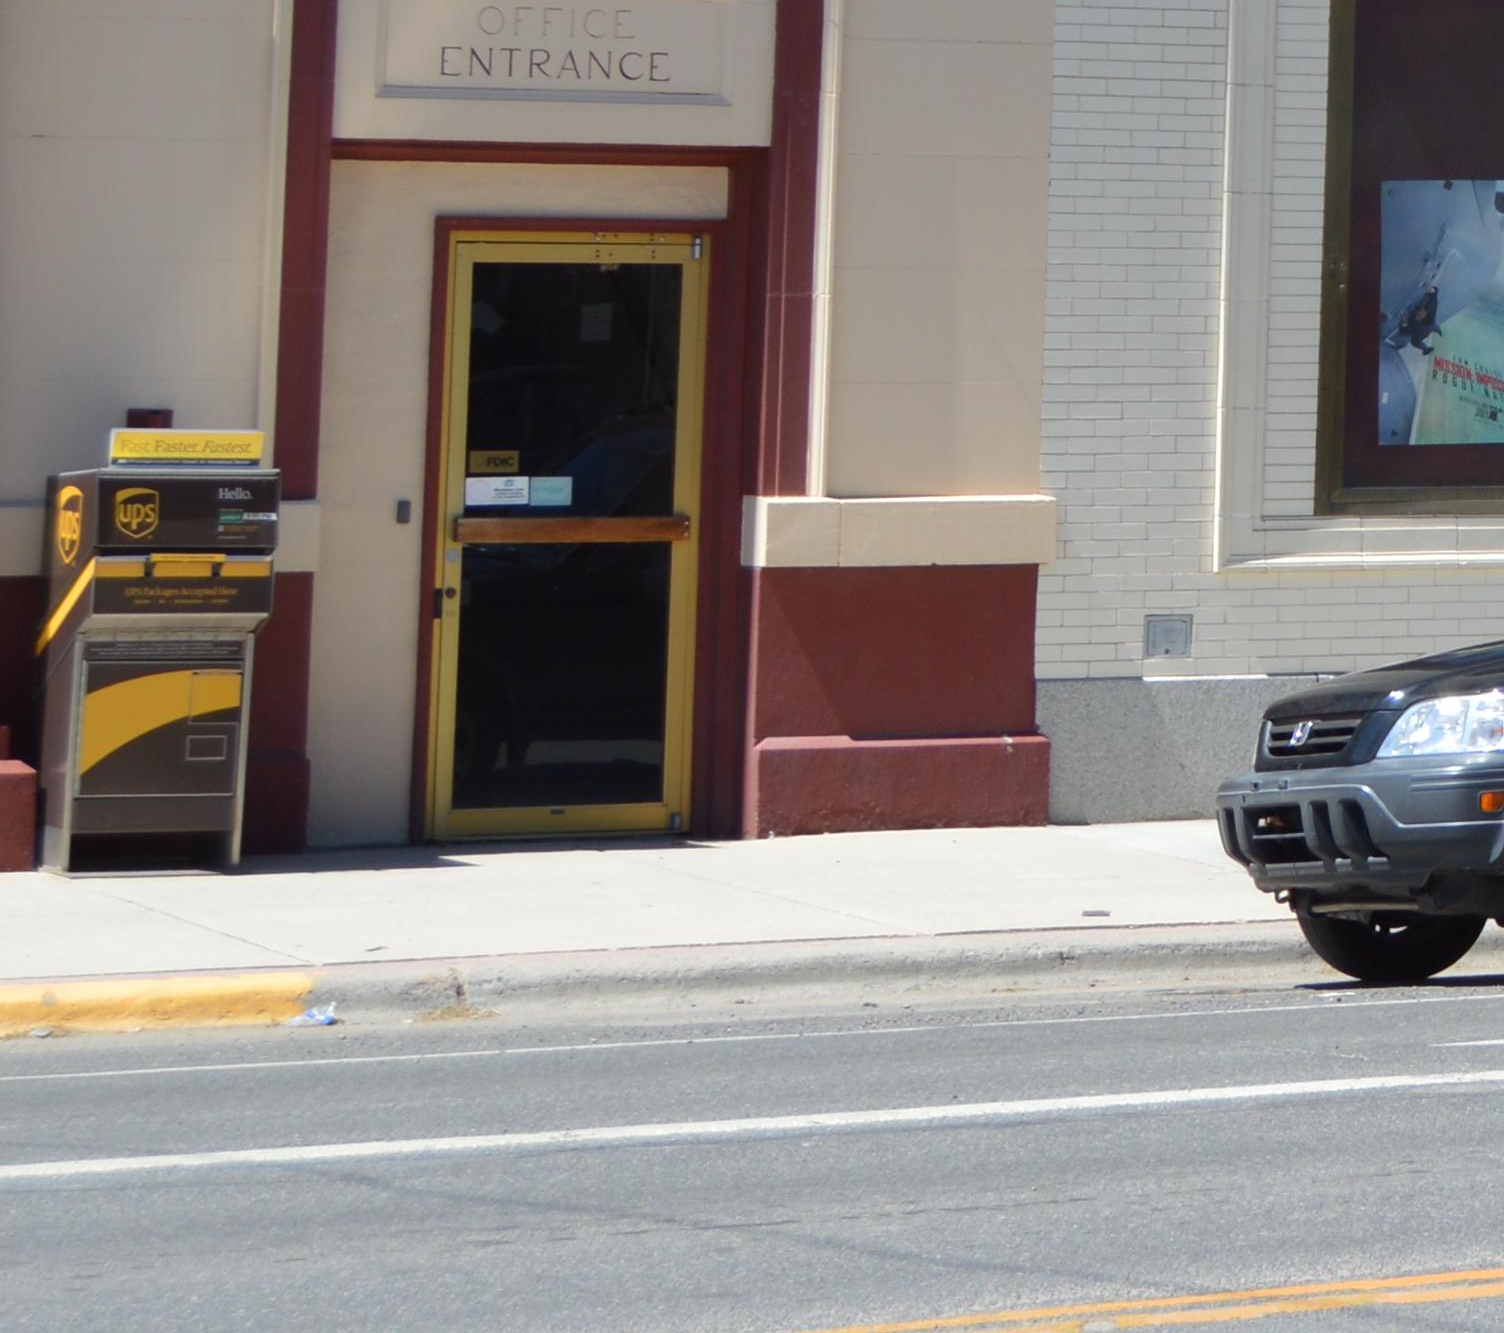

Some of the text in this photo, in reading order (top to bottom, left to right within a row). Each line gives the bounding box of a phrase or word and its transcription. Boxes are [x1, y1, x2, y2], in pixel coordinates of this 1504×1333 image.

[476, 5, 637, 40] OFFICE
[439, 45, 671, 83] ENTRANCE
[486, 456, 515, 468] FDIC
[217, 486, 253, 500] Hello.
[58, 509, 81, 551] ups
[119, 501, 156, 531] ups
